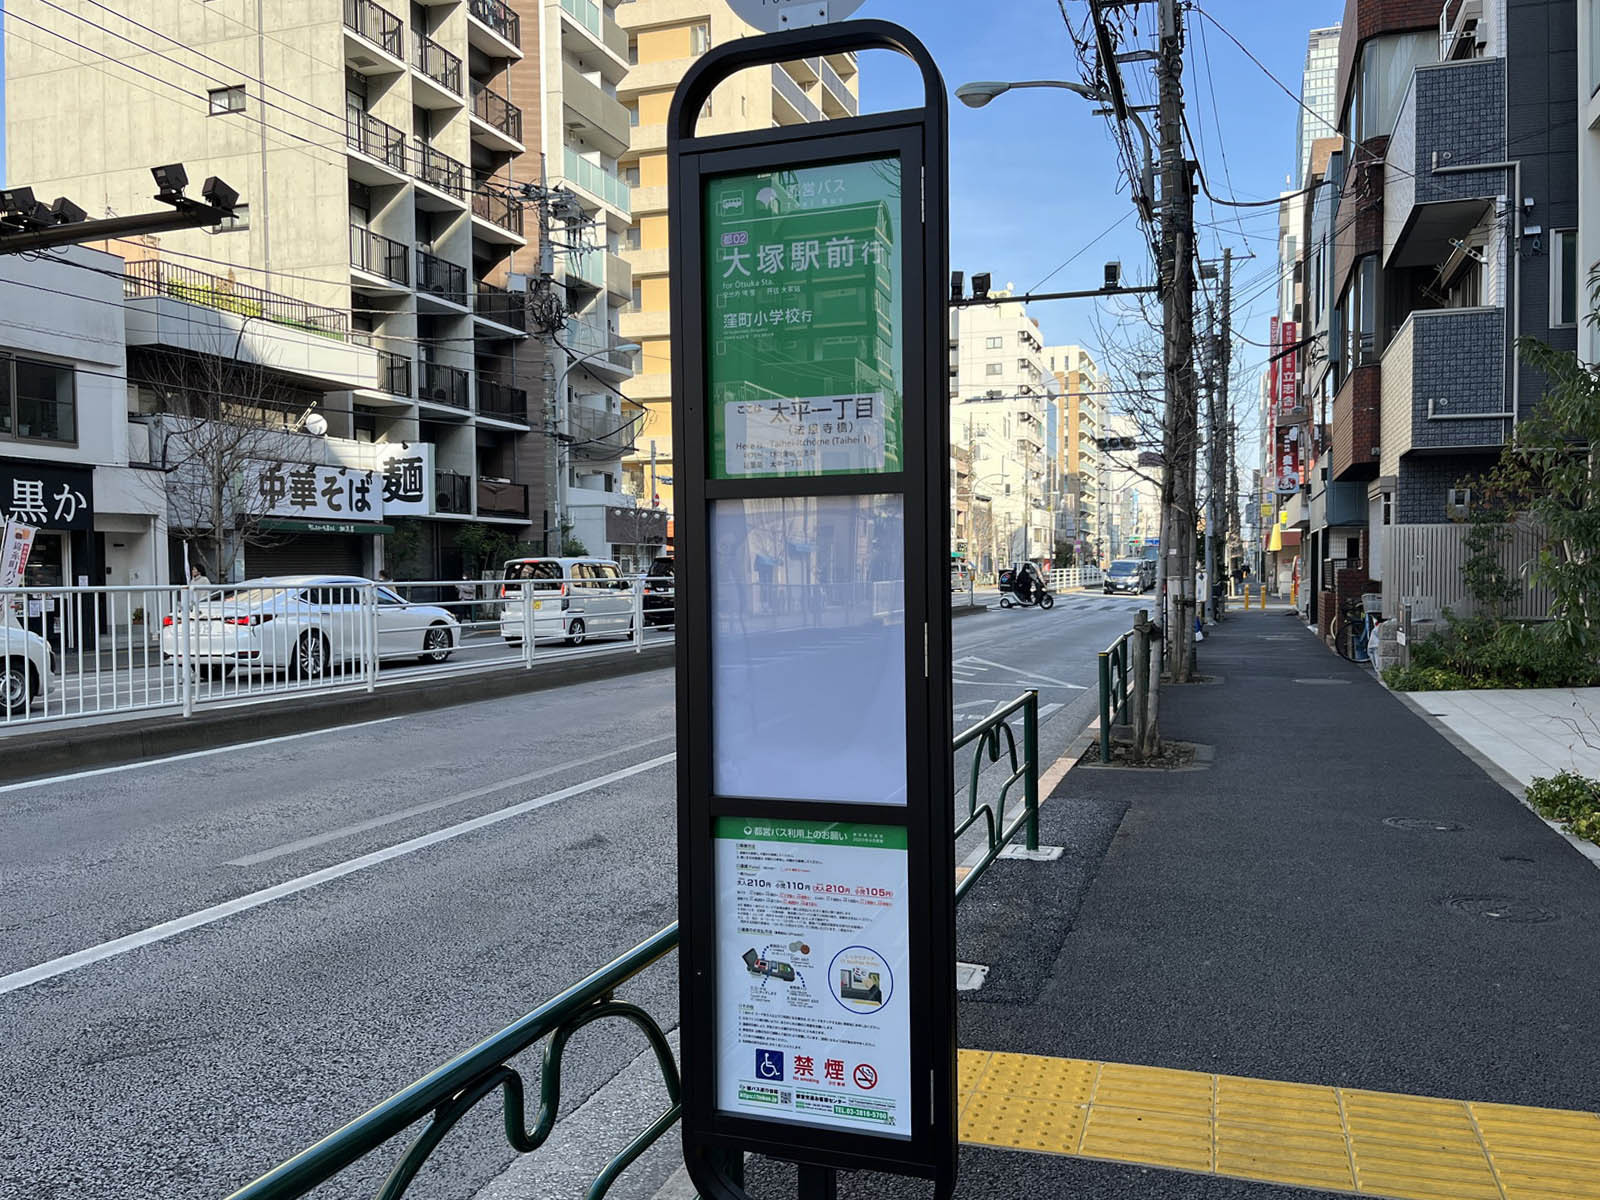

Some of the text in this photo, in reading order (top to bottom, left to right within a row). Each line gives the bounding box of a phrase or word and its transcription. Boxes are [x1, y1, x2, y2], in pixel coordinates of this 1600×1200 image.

[722, 236, 883, 279] 大塚駅前行
[722, 308, 814, 329] 窪町小学校行
[769, 397, 874, 424] 太平一丁目
[258, 466, 373, 512] 中華そば
[382, 455, 424, 503] 麺
[0, 478, 87, 523] 黒か
[753, 826, 849, 842] 都営バス利用上のお願い
[793, 1054, 846, 1082] 禁煙
